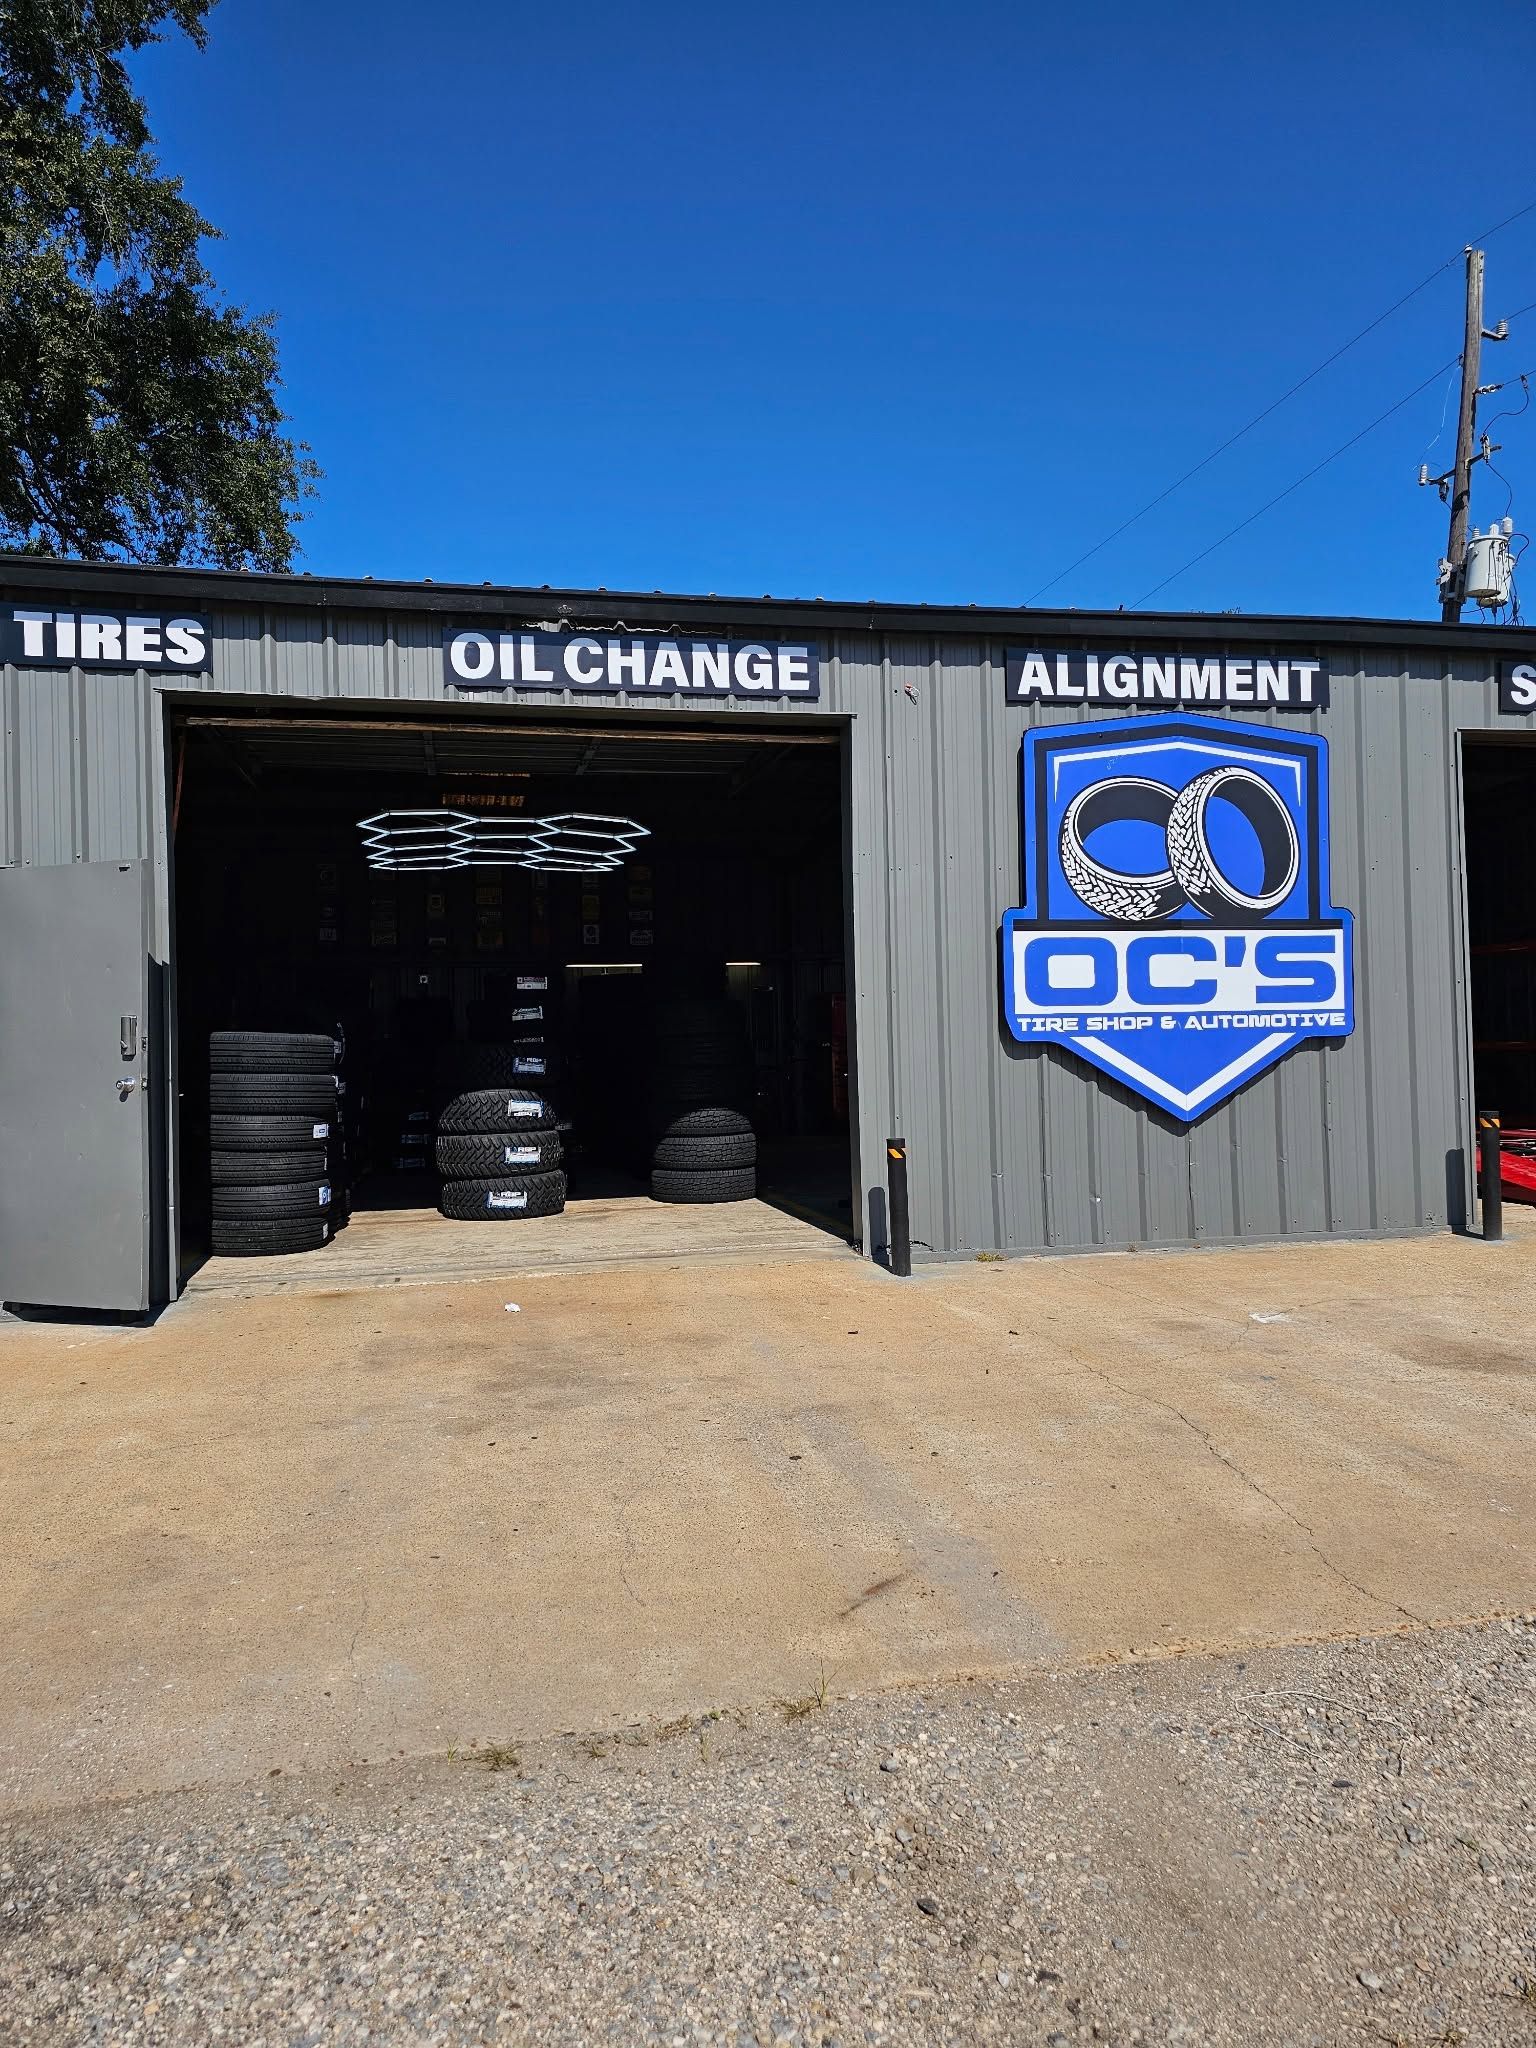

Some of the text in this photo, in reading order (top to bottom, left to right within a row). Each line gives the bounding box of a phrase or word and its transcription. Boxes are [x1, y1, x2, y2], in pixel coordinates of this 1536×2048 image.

[13, 610, 206, 666] TIRES
[450, 632, 811, 692] OIL CHANGE
[1017, 652, 1321, 702] ALIGNMENT
[1024, 934, 1337, 1007] OC'S
[1016, 1012, 1346, 1033] TIRE SHOP & AUTOMOTIVE
